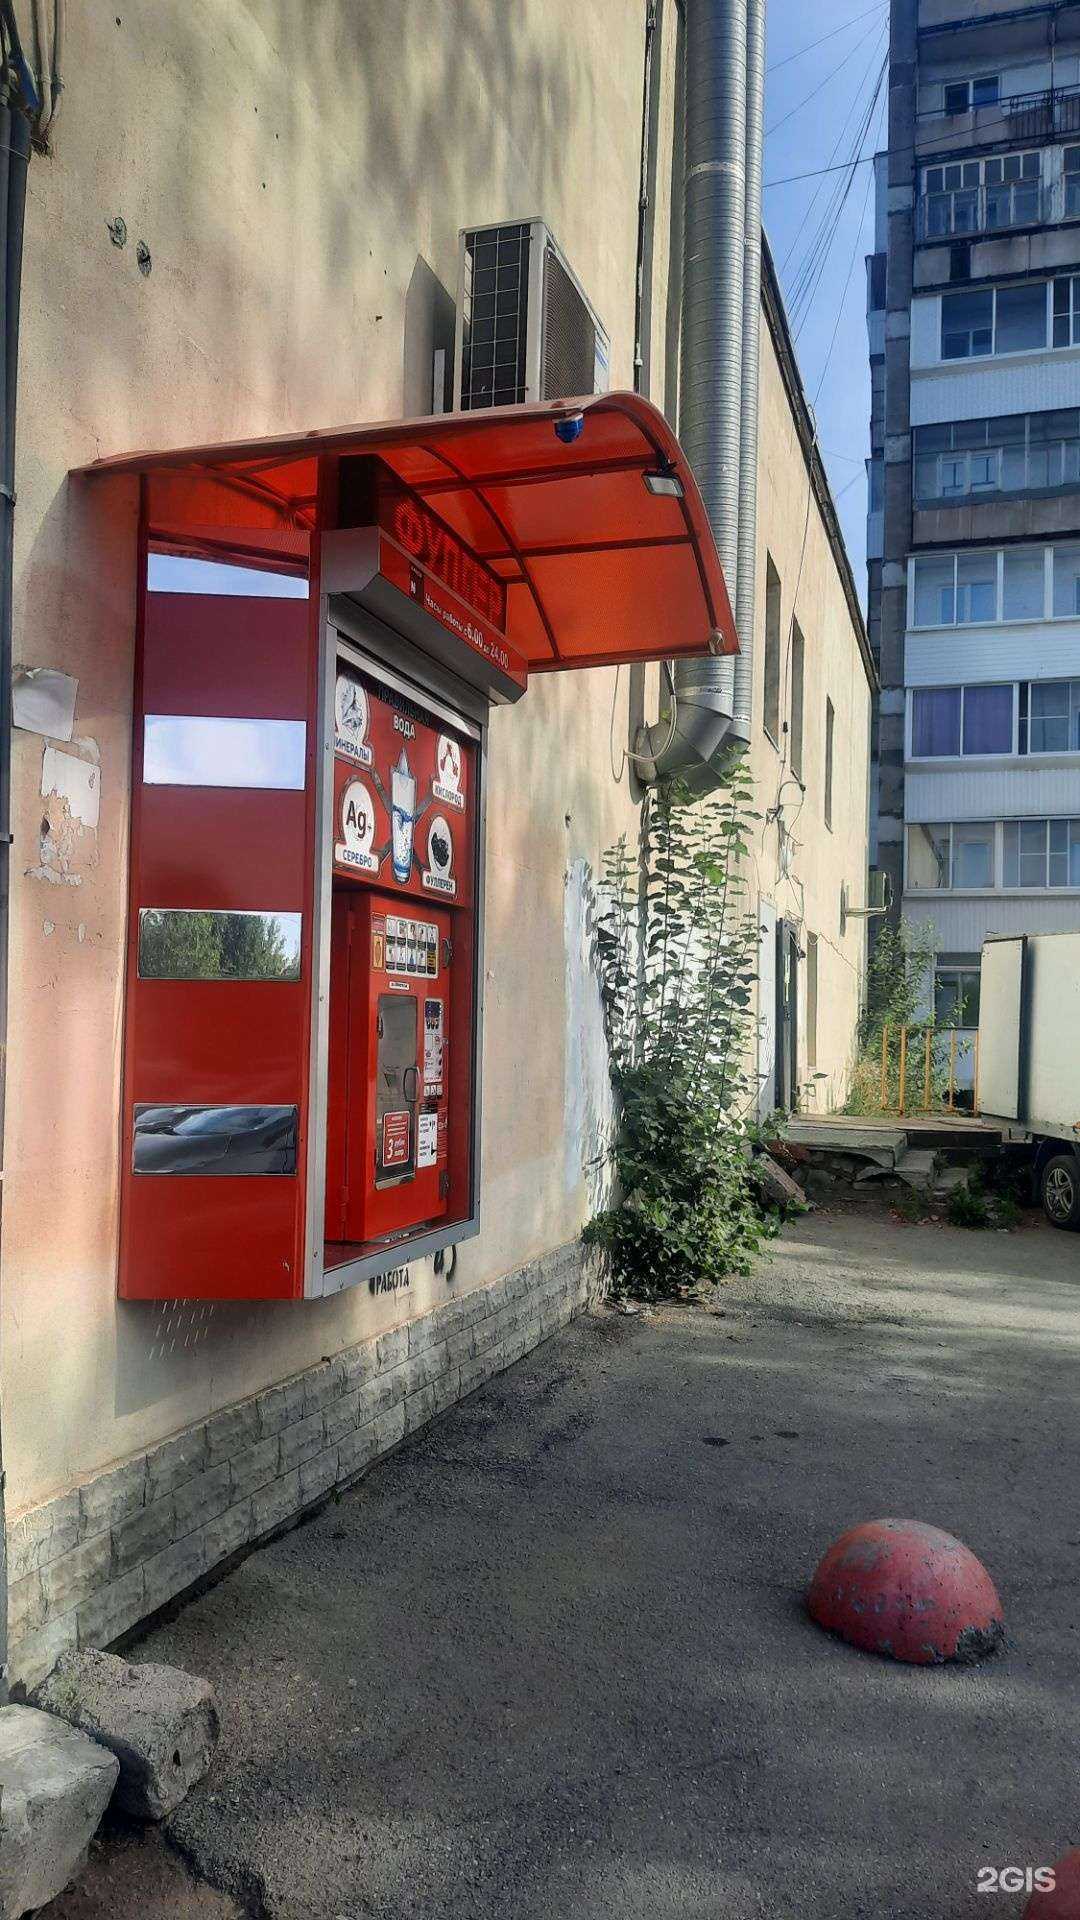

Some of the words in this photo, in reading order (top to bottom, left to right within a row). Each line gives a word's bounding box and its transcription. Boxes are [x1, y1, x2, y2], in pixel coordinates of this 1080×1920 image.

[393, 714, 416, 740] ВОДА
[334, 737, 370, 762] ИНЕРАЛЫ
[342, 848, 372, 868] СЕРЕБРО
